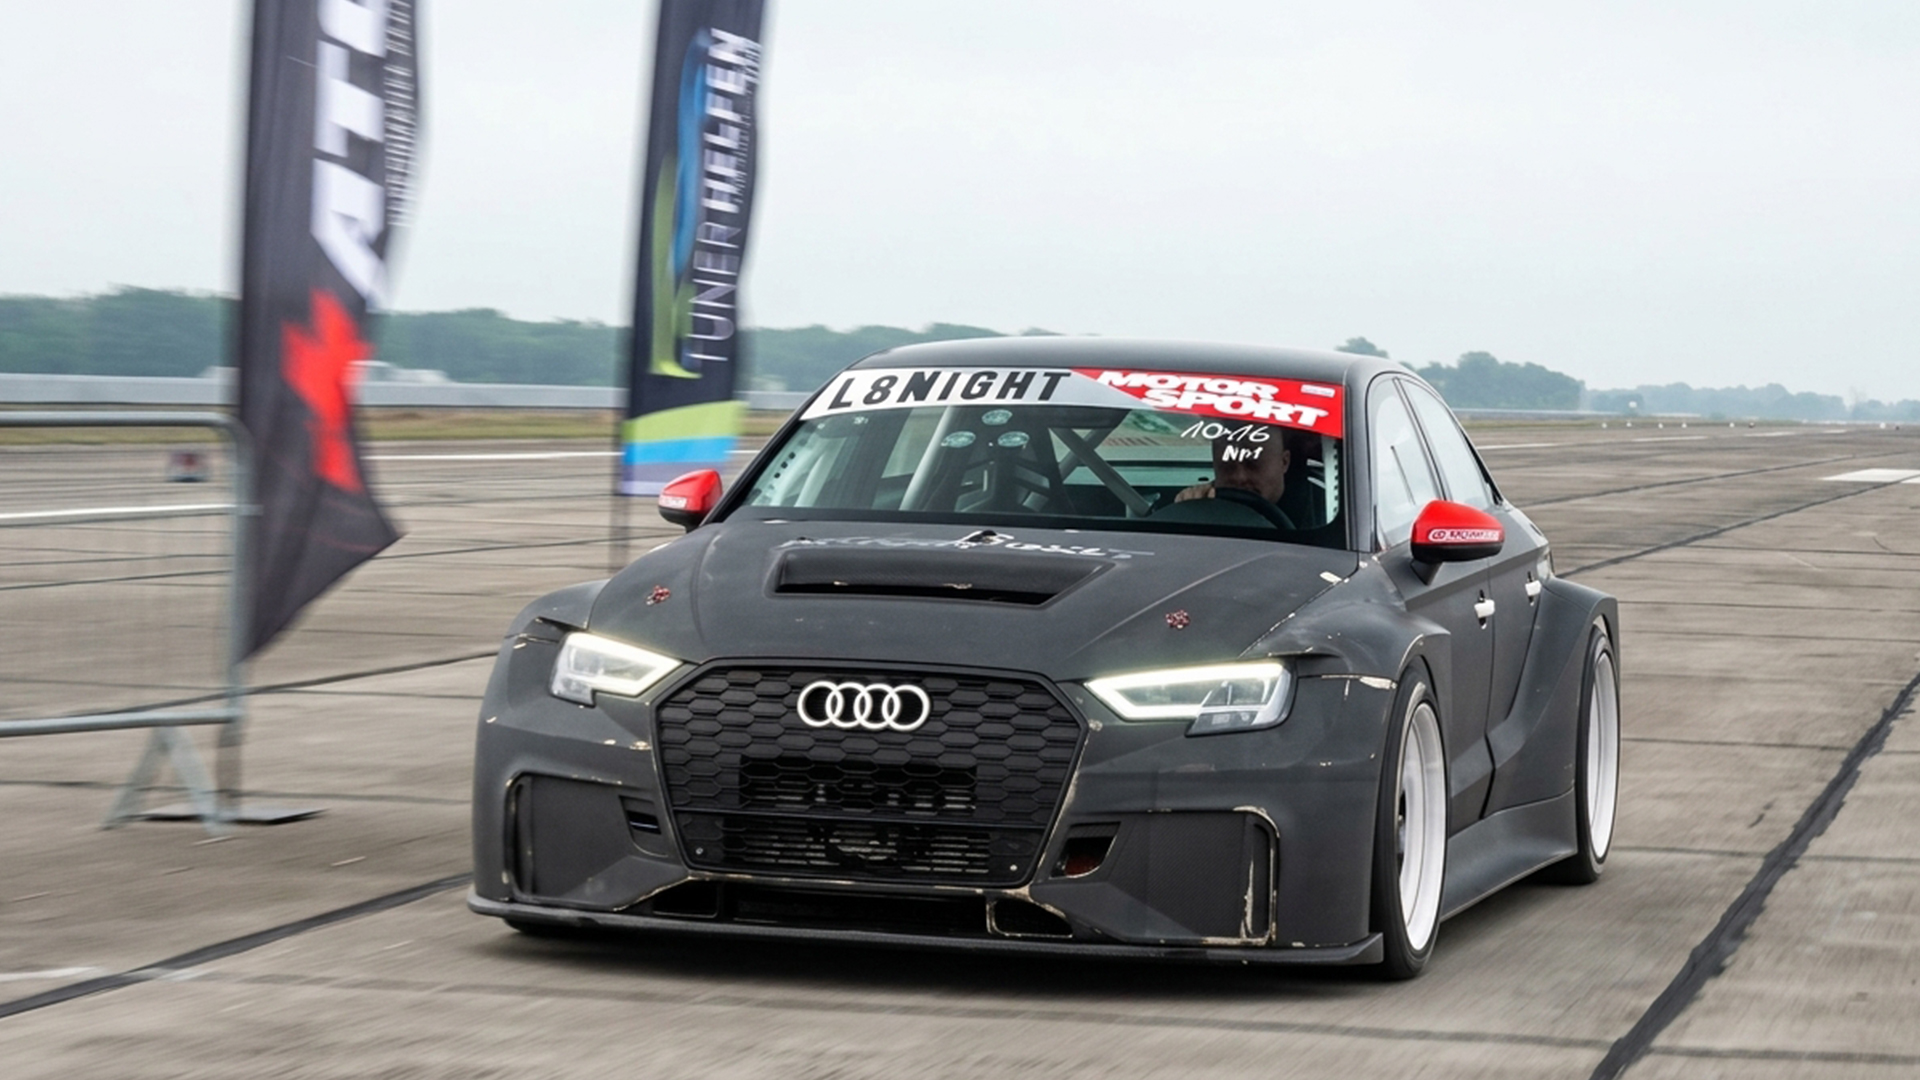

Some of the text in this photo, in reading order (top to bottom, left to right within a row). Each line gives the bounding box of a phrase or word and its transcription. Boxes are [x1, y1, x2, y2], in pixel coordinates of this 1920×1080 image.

[828, 371, 1071, 410] L8NIGHT
[1096, 371, 1279, 400] MOTOR
[1143, 389, 1329, 427] SPORT
